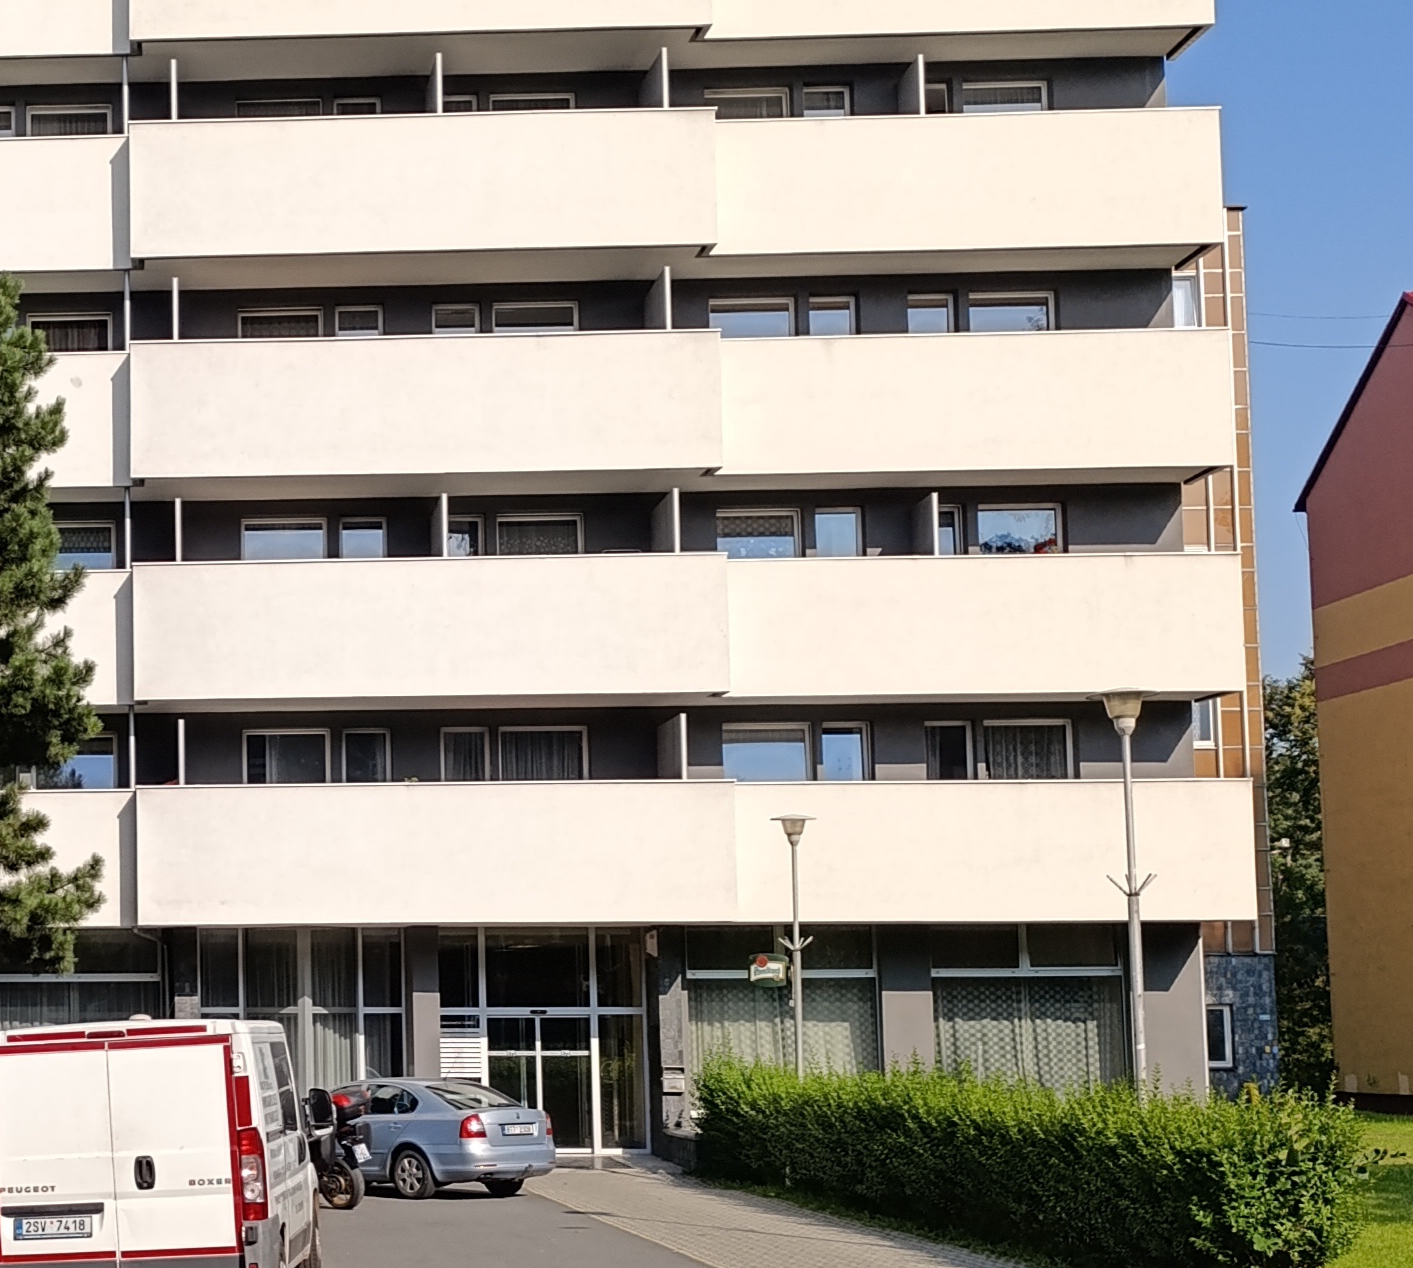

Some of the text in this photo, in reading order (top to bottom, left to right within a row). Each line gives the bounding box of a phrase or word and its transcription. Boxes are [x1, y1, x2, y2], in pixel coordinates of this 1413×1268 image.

[188, 1178, 232, 1186] BOXER
[25, 1219, 86, 1233] 2SV 7418
